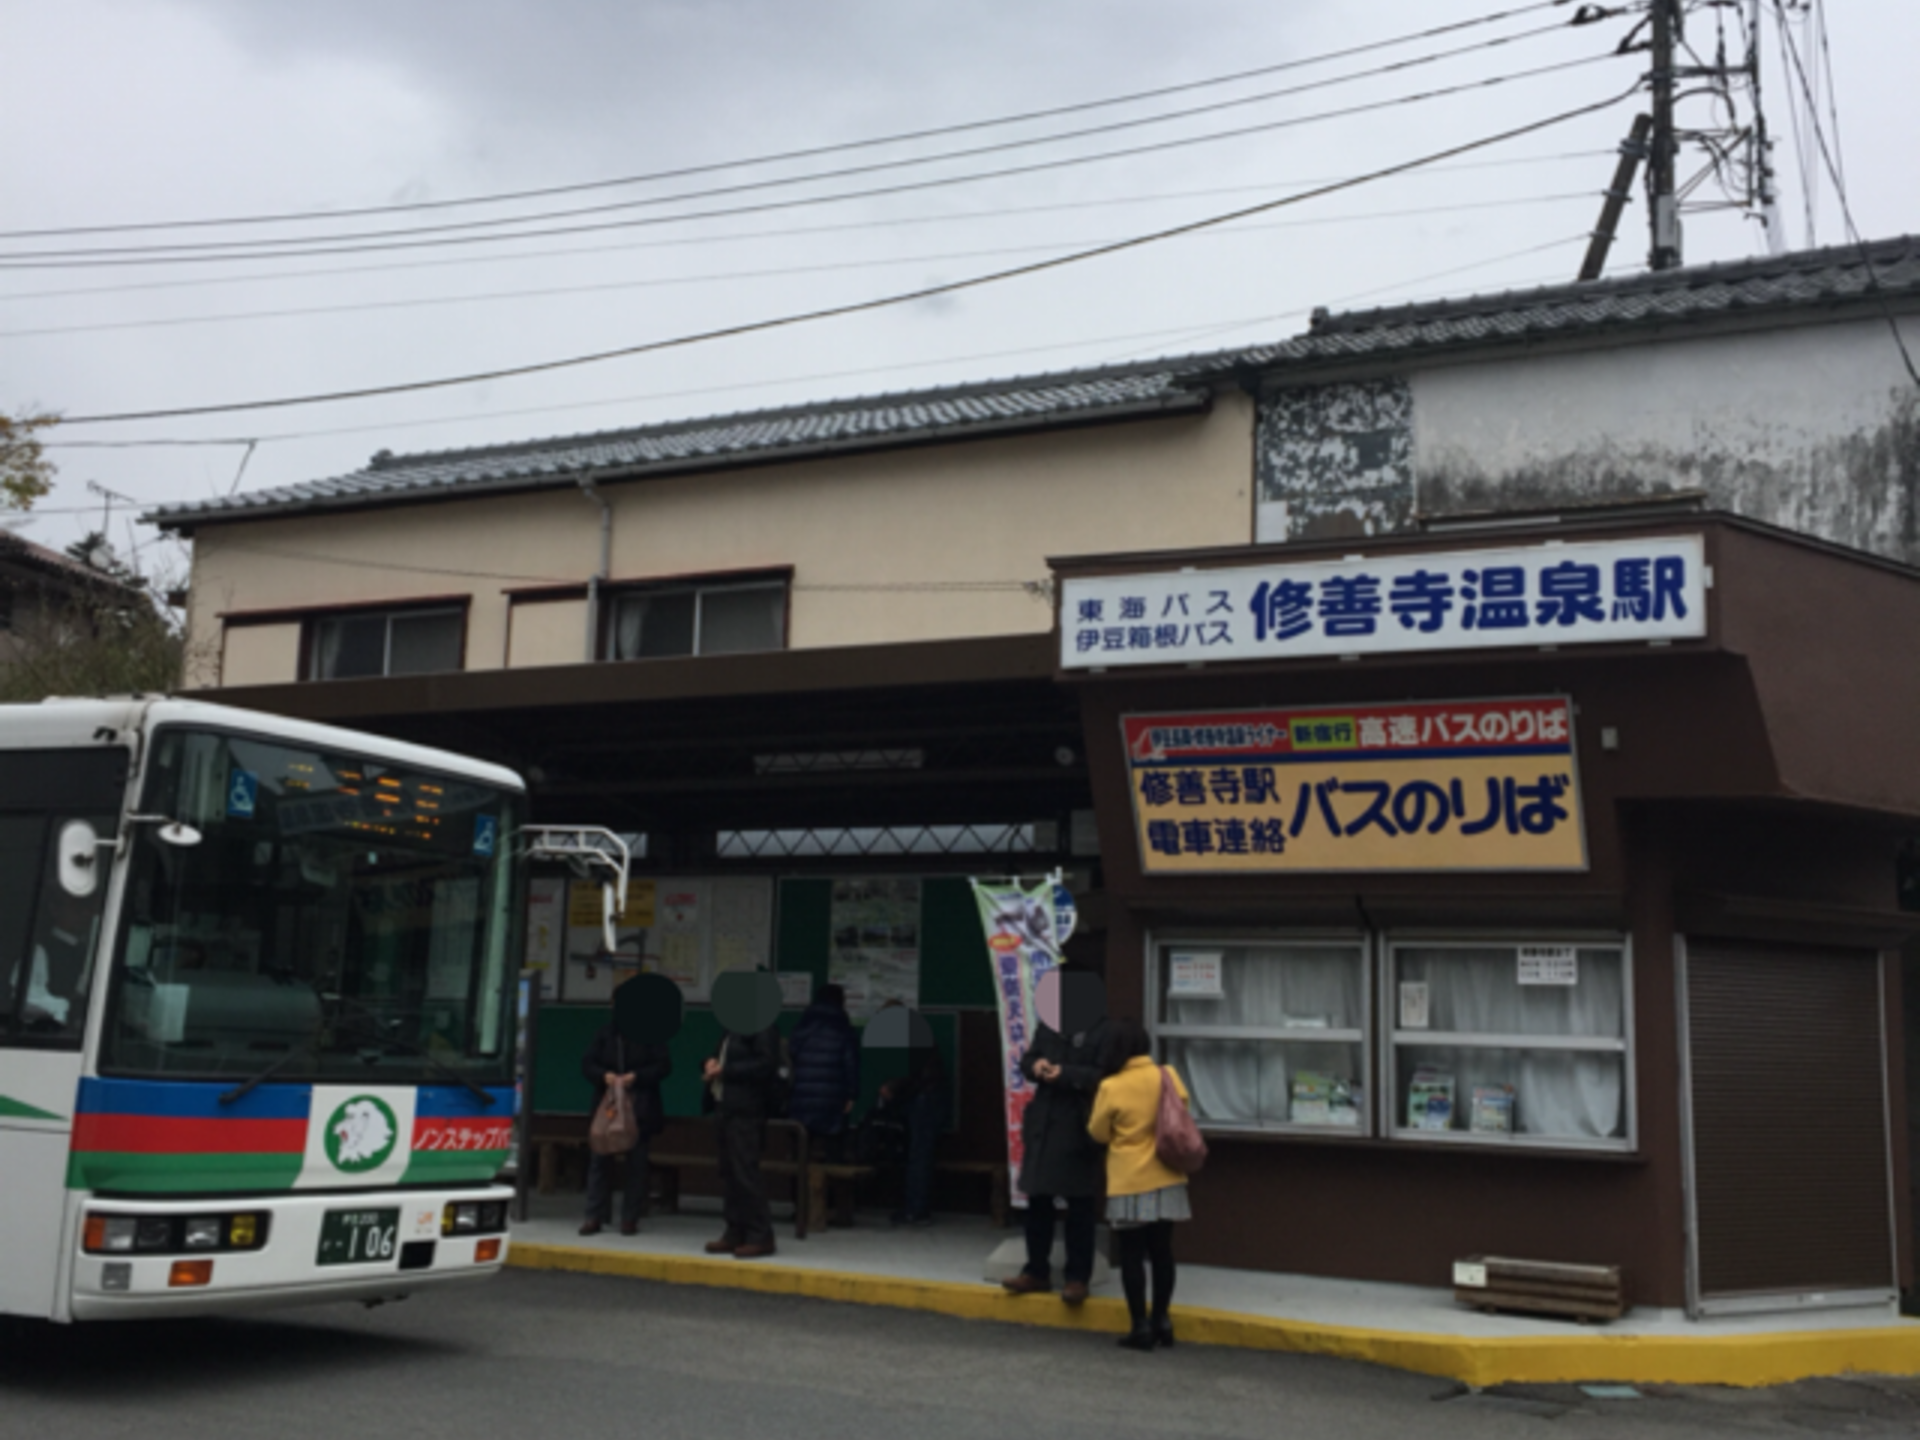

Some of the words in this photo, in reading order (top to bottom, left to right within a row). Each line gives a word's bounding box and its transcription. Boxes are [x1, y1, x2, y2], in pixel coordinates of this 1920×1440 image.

[1077, 588, 1234, 623] 東海バス
[1249, 555, 1687, 642] 修善寺温泉駅
[1075, 621, 1234, 653] 伊豆箱根バス
[1359, 707, 1567, 746] 高速バスのりば
[1140, 767, 1280, 807] 修善寺駅
[1288, 773, 1571, 838] バスのりば
[1145, 817, 1287, 856] 電車連絡
